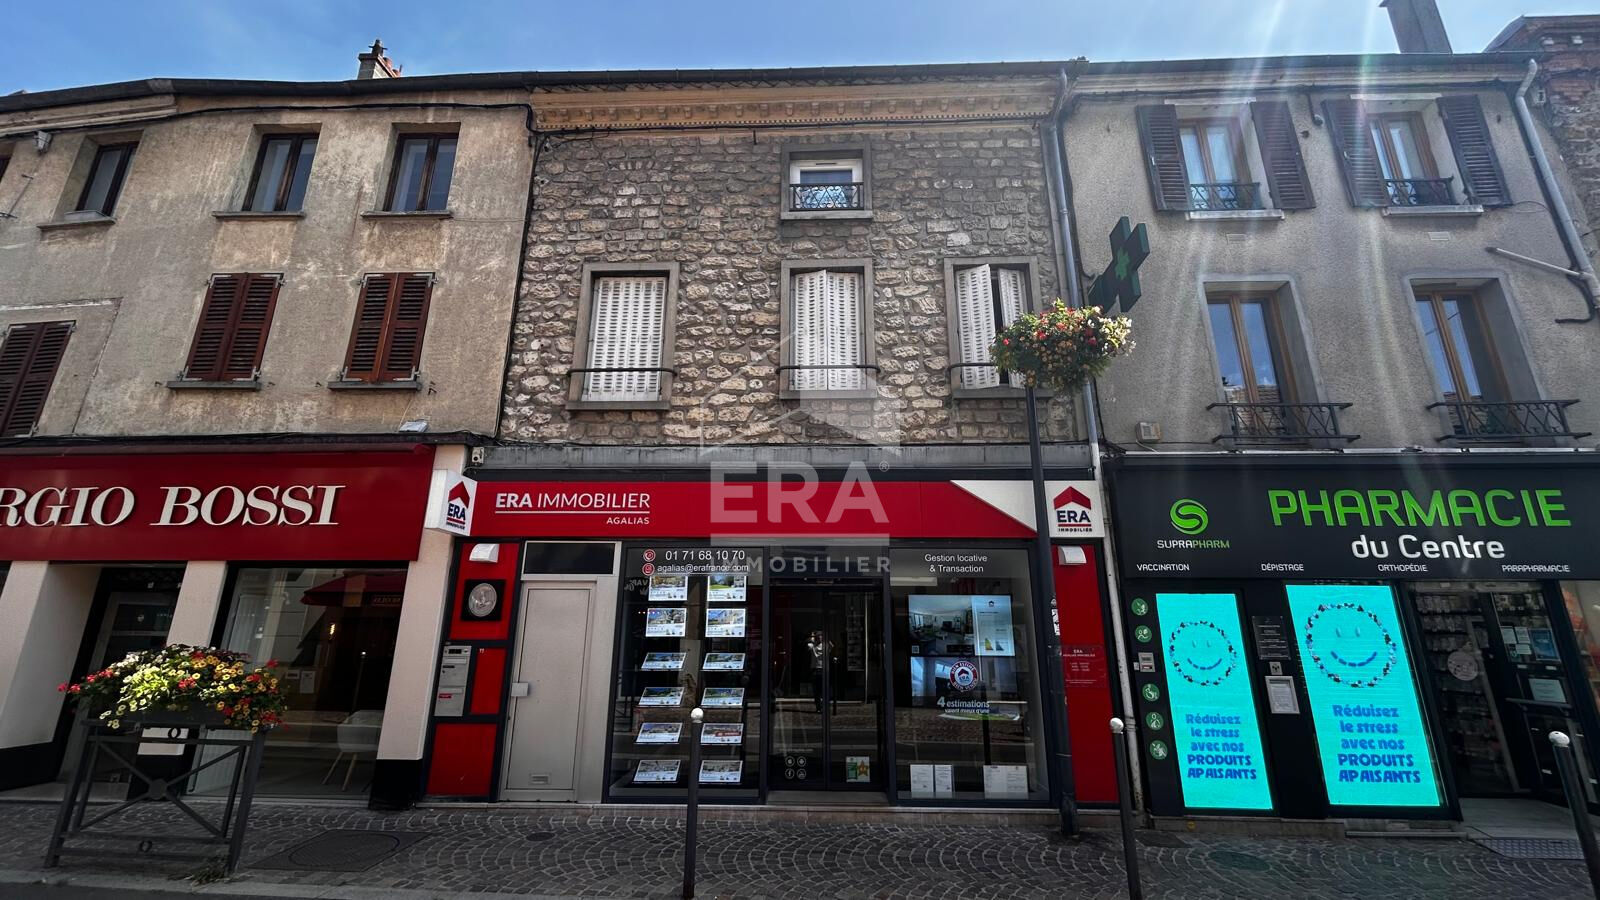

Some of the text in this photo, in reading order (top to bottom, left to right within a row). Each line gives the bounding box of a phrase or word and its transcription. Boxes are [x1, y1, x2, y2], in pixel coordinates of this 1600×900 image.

[150, 485, 346, 526] BOSSI
[496, 493, 651, 509] ERA IMMOBILIER
[447, 503, 466, 520] ERA
[1268, 489, 1572, 527] PHARMACIE
[606, 517, 650, 525] AGALIAS
[1056, 510, 1091, 523] ERA
[1156, 539, 1230, 549] SUPRAPHARM
[1351, 534, 1506, 559] du Centre
[665, 550, 745, 561] 01 71 68 10 70
[924, 553, 988, 563] Gestion locative
[657, 562, 749, 574] agalias@erafrance.com
[929, 564, 984, 573] & Transaction
[1136, 563, 1190, 571] VACCINATION
[1261, 562, 1305, 571] DÉPISTAGE
[1377, 563, 1428, 572] ORTHOPÉDIE
[1501, 564, 1571, 573] PARAPHARMACIE
[936, 696, 990, 708] 4 estimations
[1332, 703, 1400, 718] Réduisez
[1185, 712, 1242, 725] Réduisez
[1190, 727, 1240, 738] le stress
[1339, 720, 1399, 734] le stress
[1190, 742, 1245, 753] avec nos
[1341, 739, 1405, 751] avec nos
[1187, 754, 1252, 766] PRODUITS
[1337, 753, 1414, 767] PRODUITS
[1187, 767, 1257, 780] APAISANTS
[1338, 769, 1421, 784] APAISANTS
